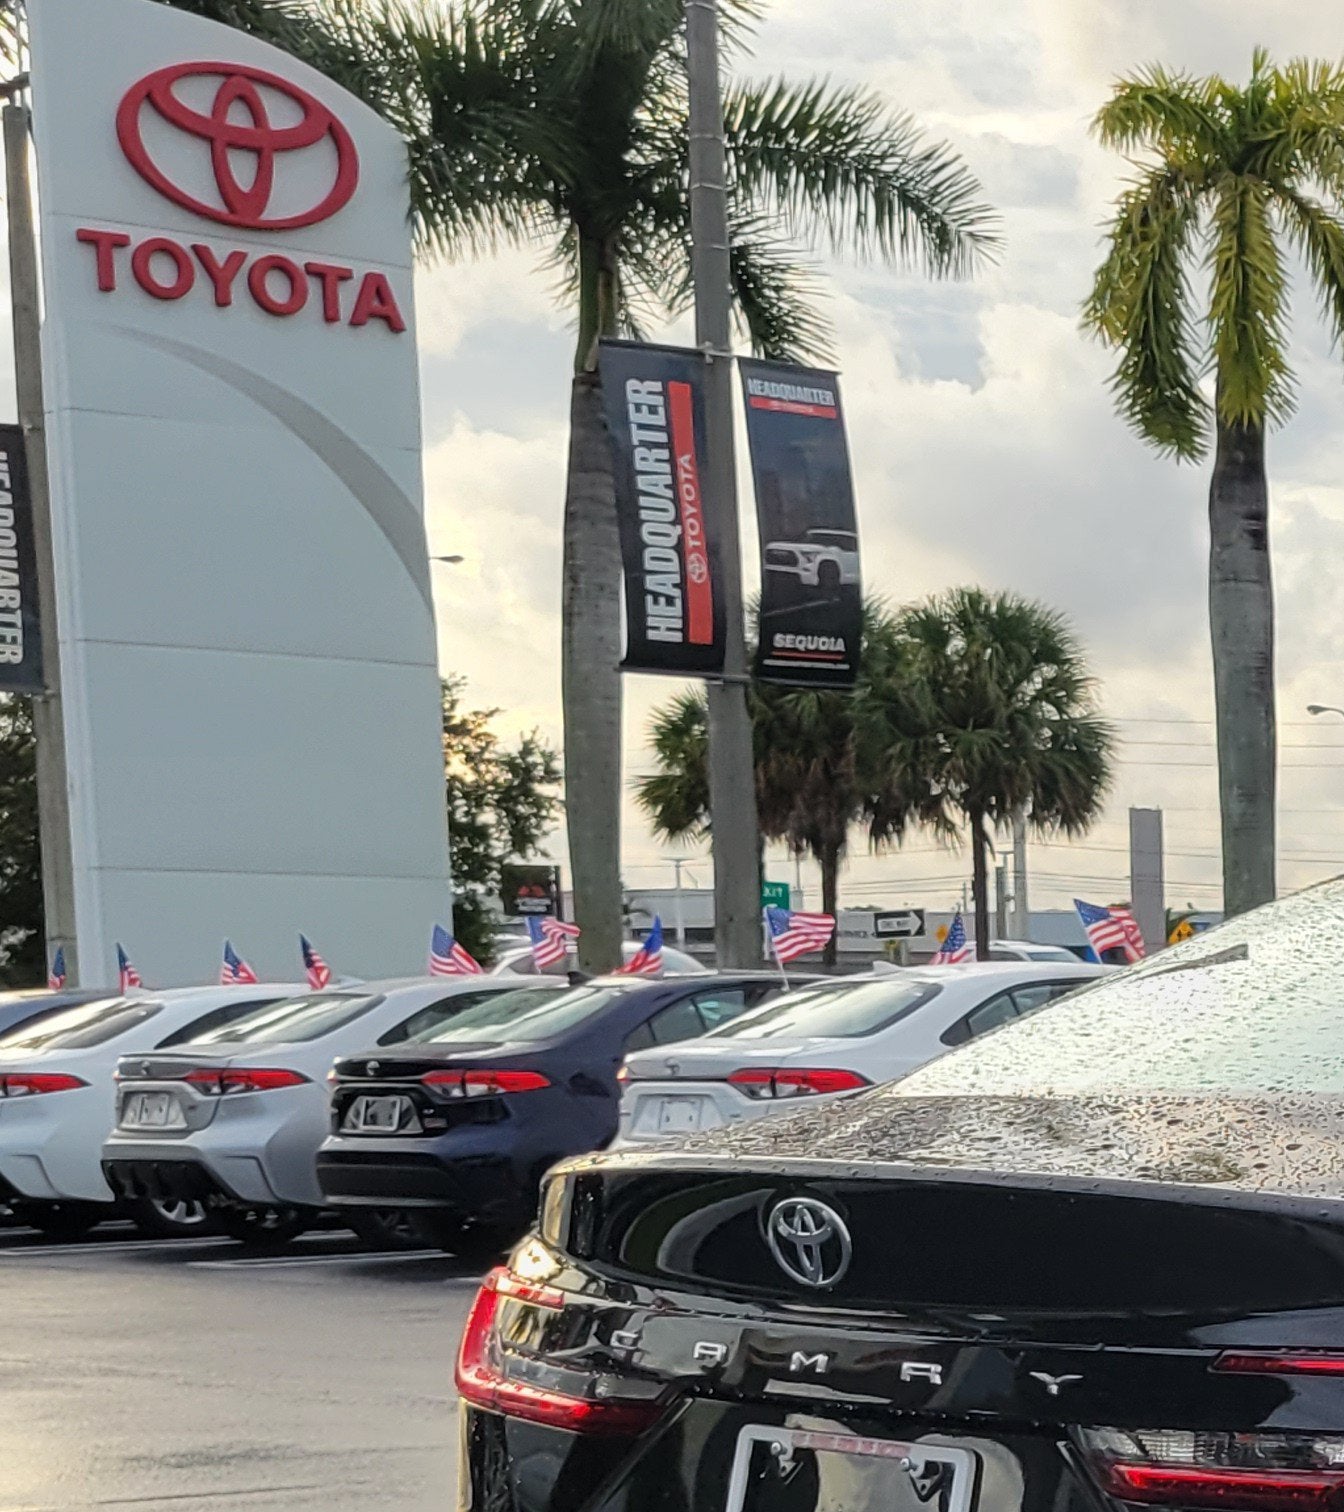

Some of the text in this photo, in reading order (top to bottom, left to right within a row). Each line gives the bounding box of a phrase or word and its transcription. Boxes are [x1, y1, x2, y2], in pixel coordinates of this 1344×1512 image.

[77, 228, 405, 334] TOYOTA
[626, 378, 685, 643] HEADQUARTER
[676, 454, 710, 549] TOYOTA
[772, 633, 846, 652] SEQUOIA
[609, 1328, 1084, 1396] CAMRY
